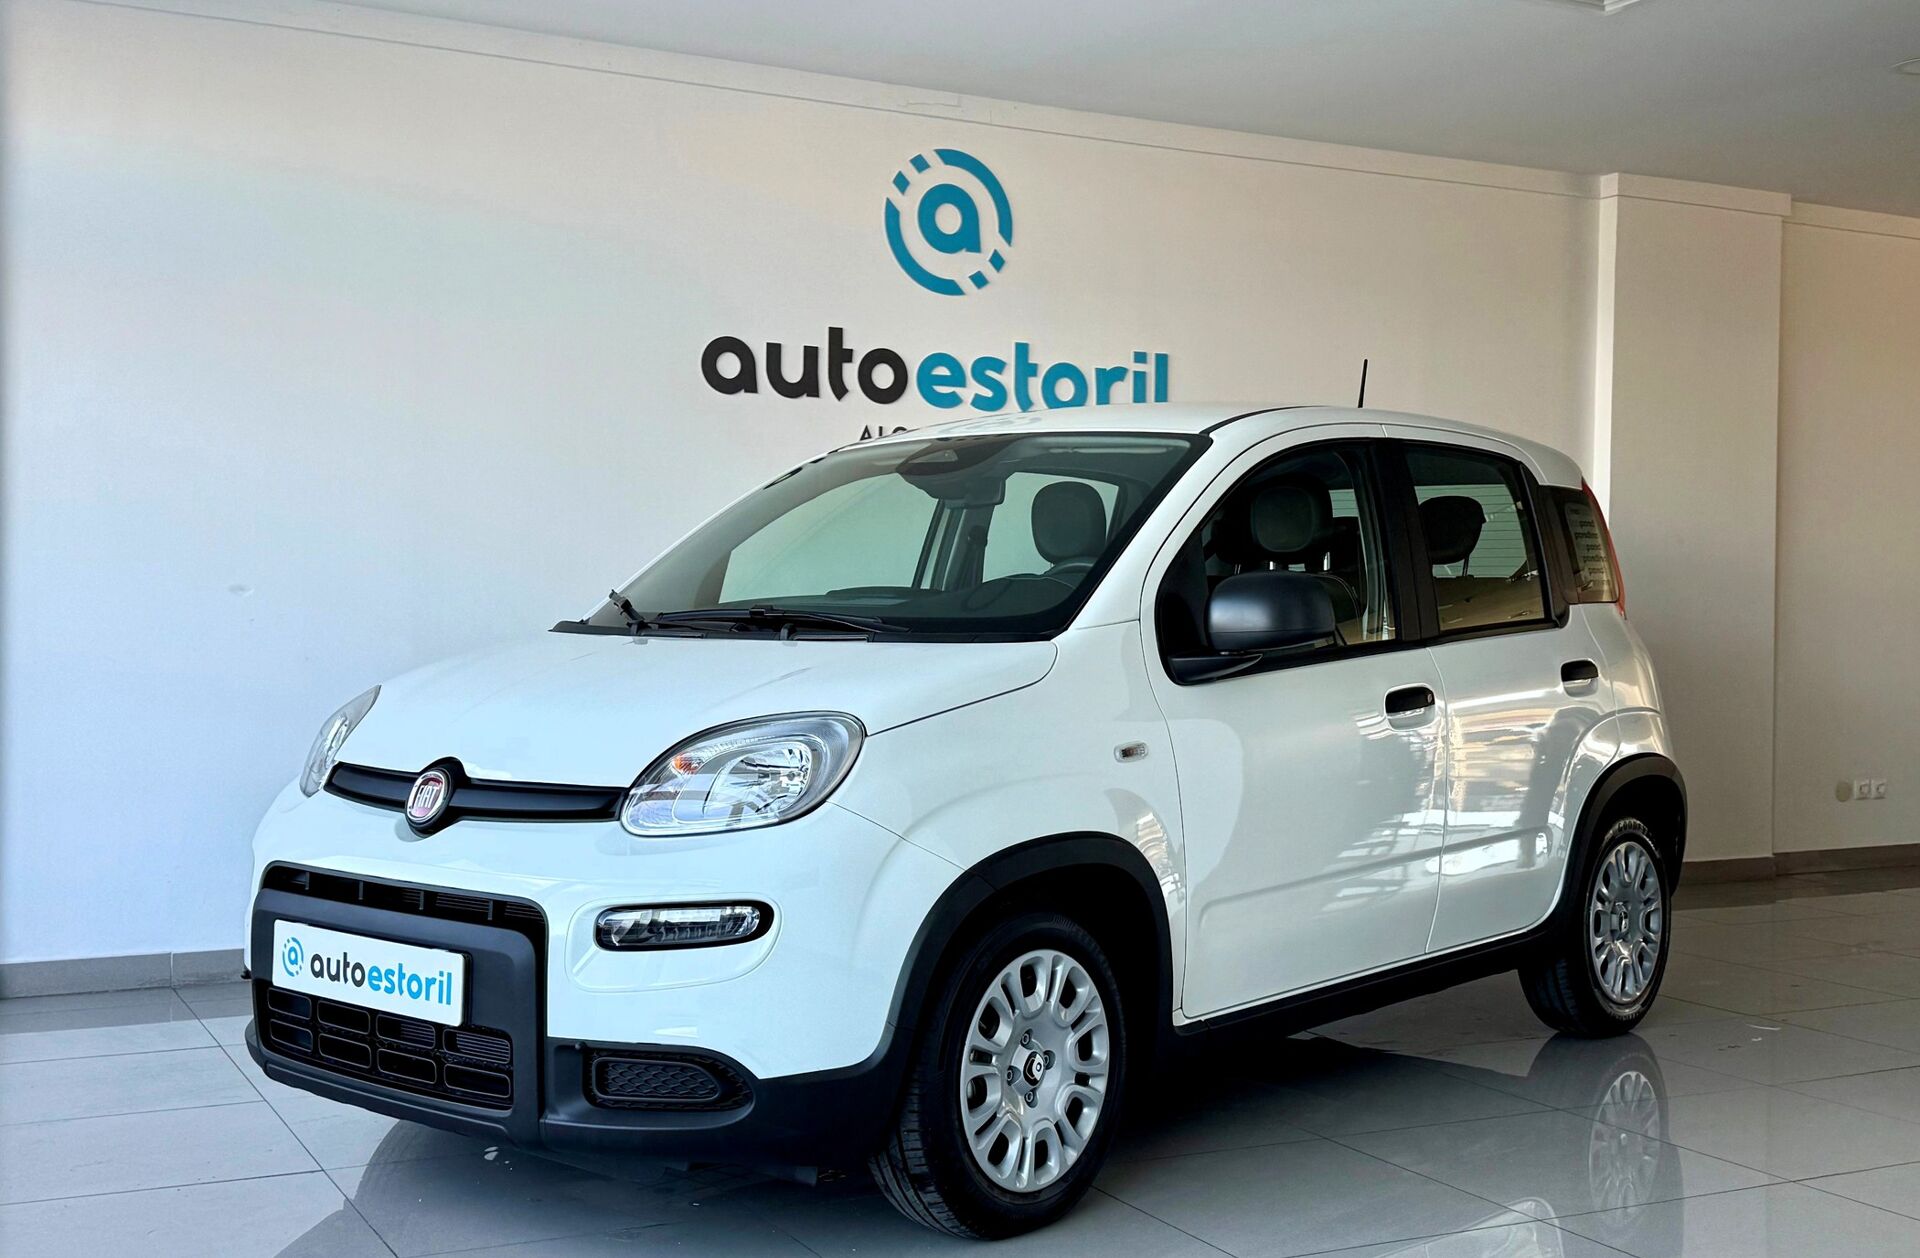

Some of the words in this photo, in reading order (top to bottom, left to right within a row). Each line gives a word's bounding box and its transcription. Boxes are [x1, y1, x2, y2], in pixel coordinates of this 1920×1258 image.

[701, 326, 1168, 413] autoestoril
[413, 785, 440, 808] FIAT
[310, 952, 452, 1005] autoestoril
